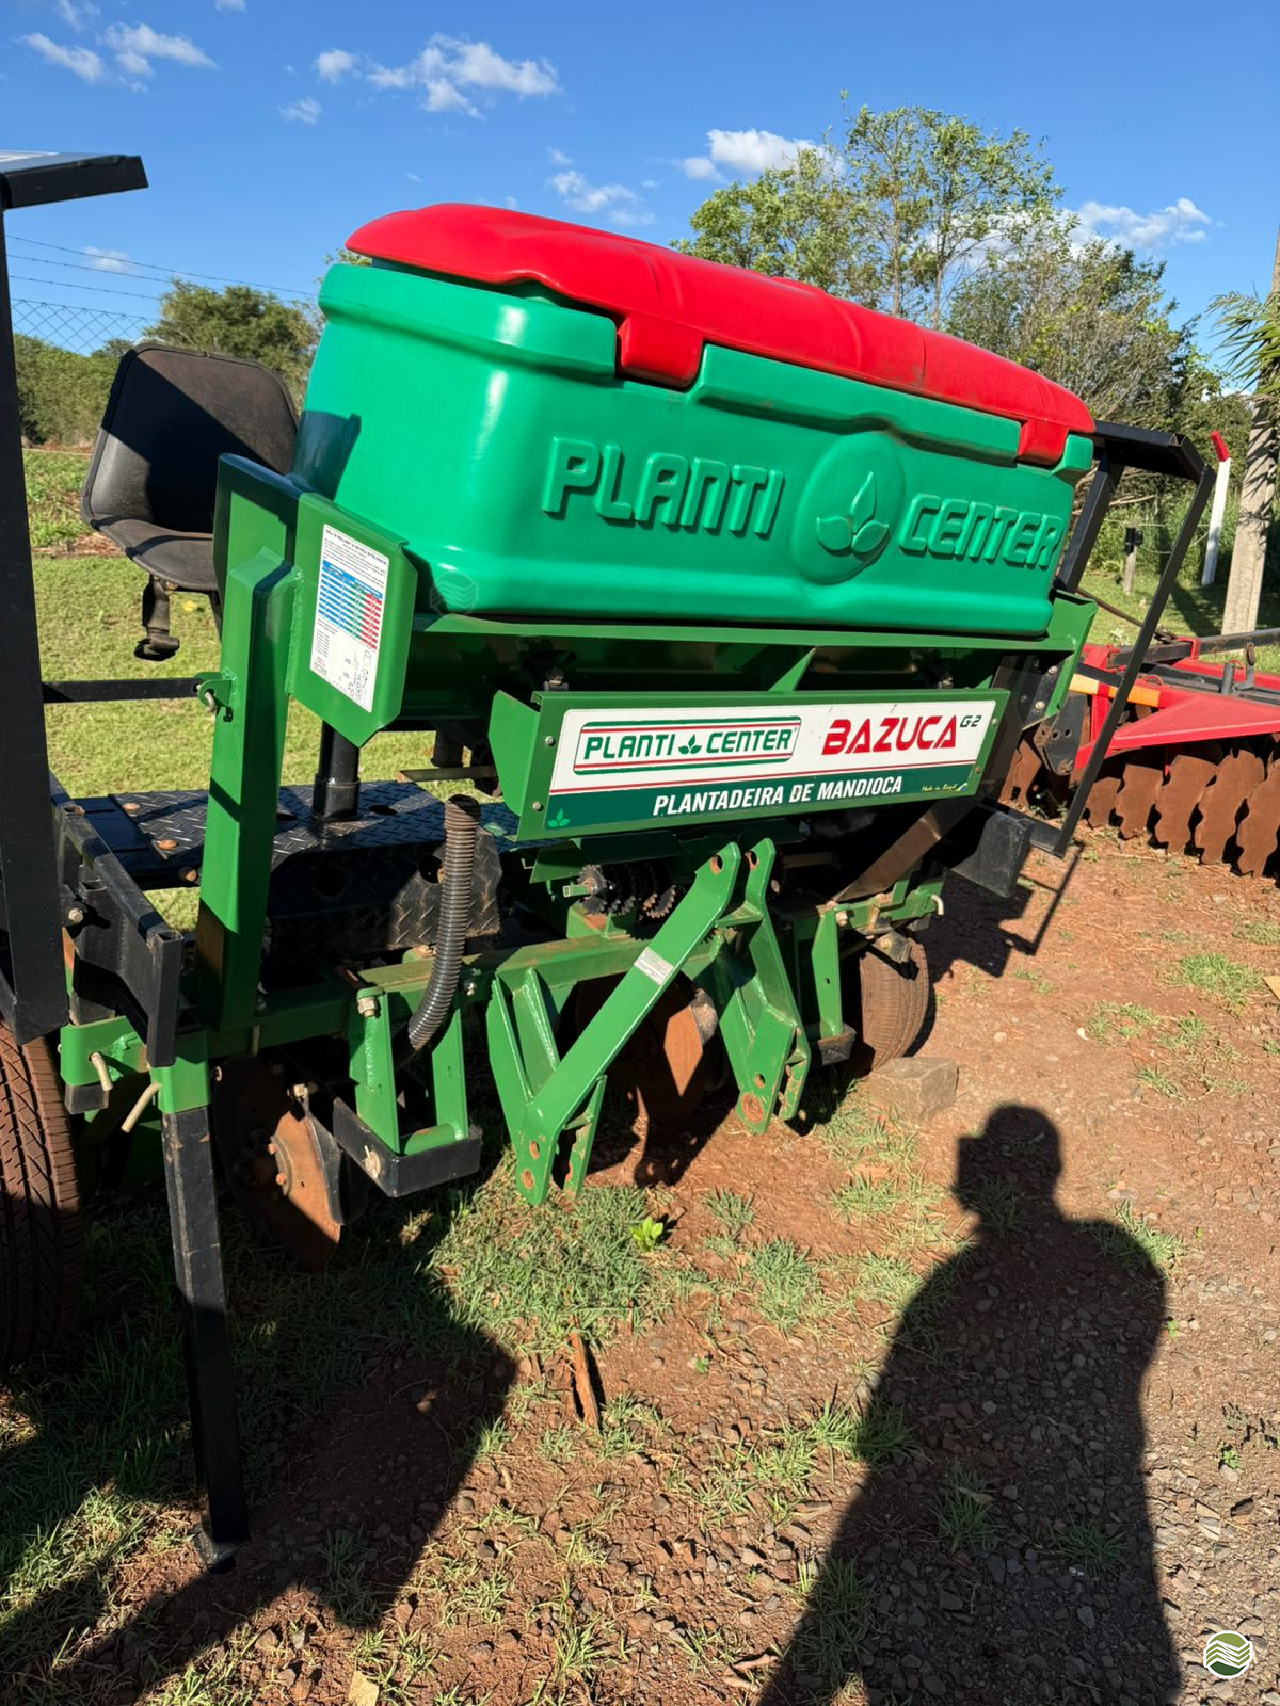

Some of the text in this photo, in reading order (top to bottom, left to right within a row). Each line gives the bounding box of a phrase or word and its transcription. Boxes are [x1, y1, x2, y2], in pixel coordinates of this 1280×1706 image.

[541, 436, 1064, 569] PLANTI CENTER
[583, 728, 794, 760] PLANTI CENTER
[821, 714, 957, 756] BAZUCA
[653, 775, 902, 816] PLANTADEIRA DE MANDIOCA
